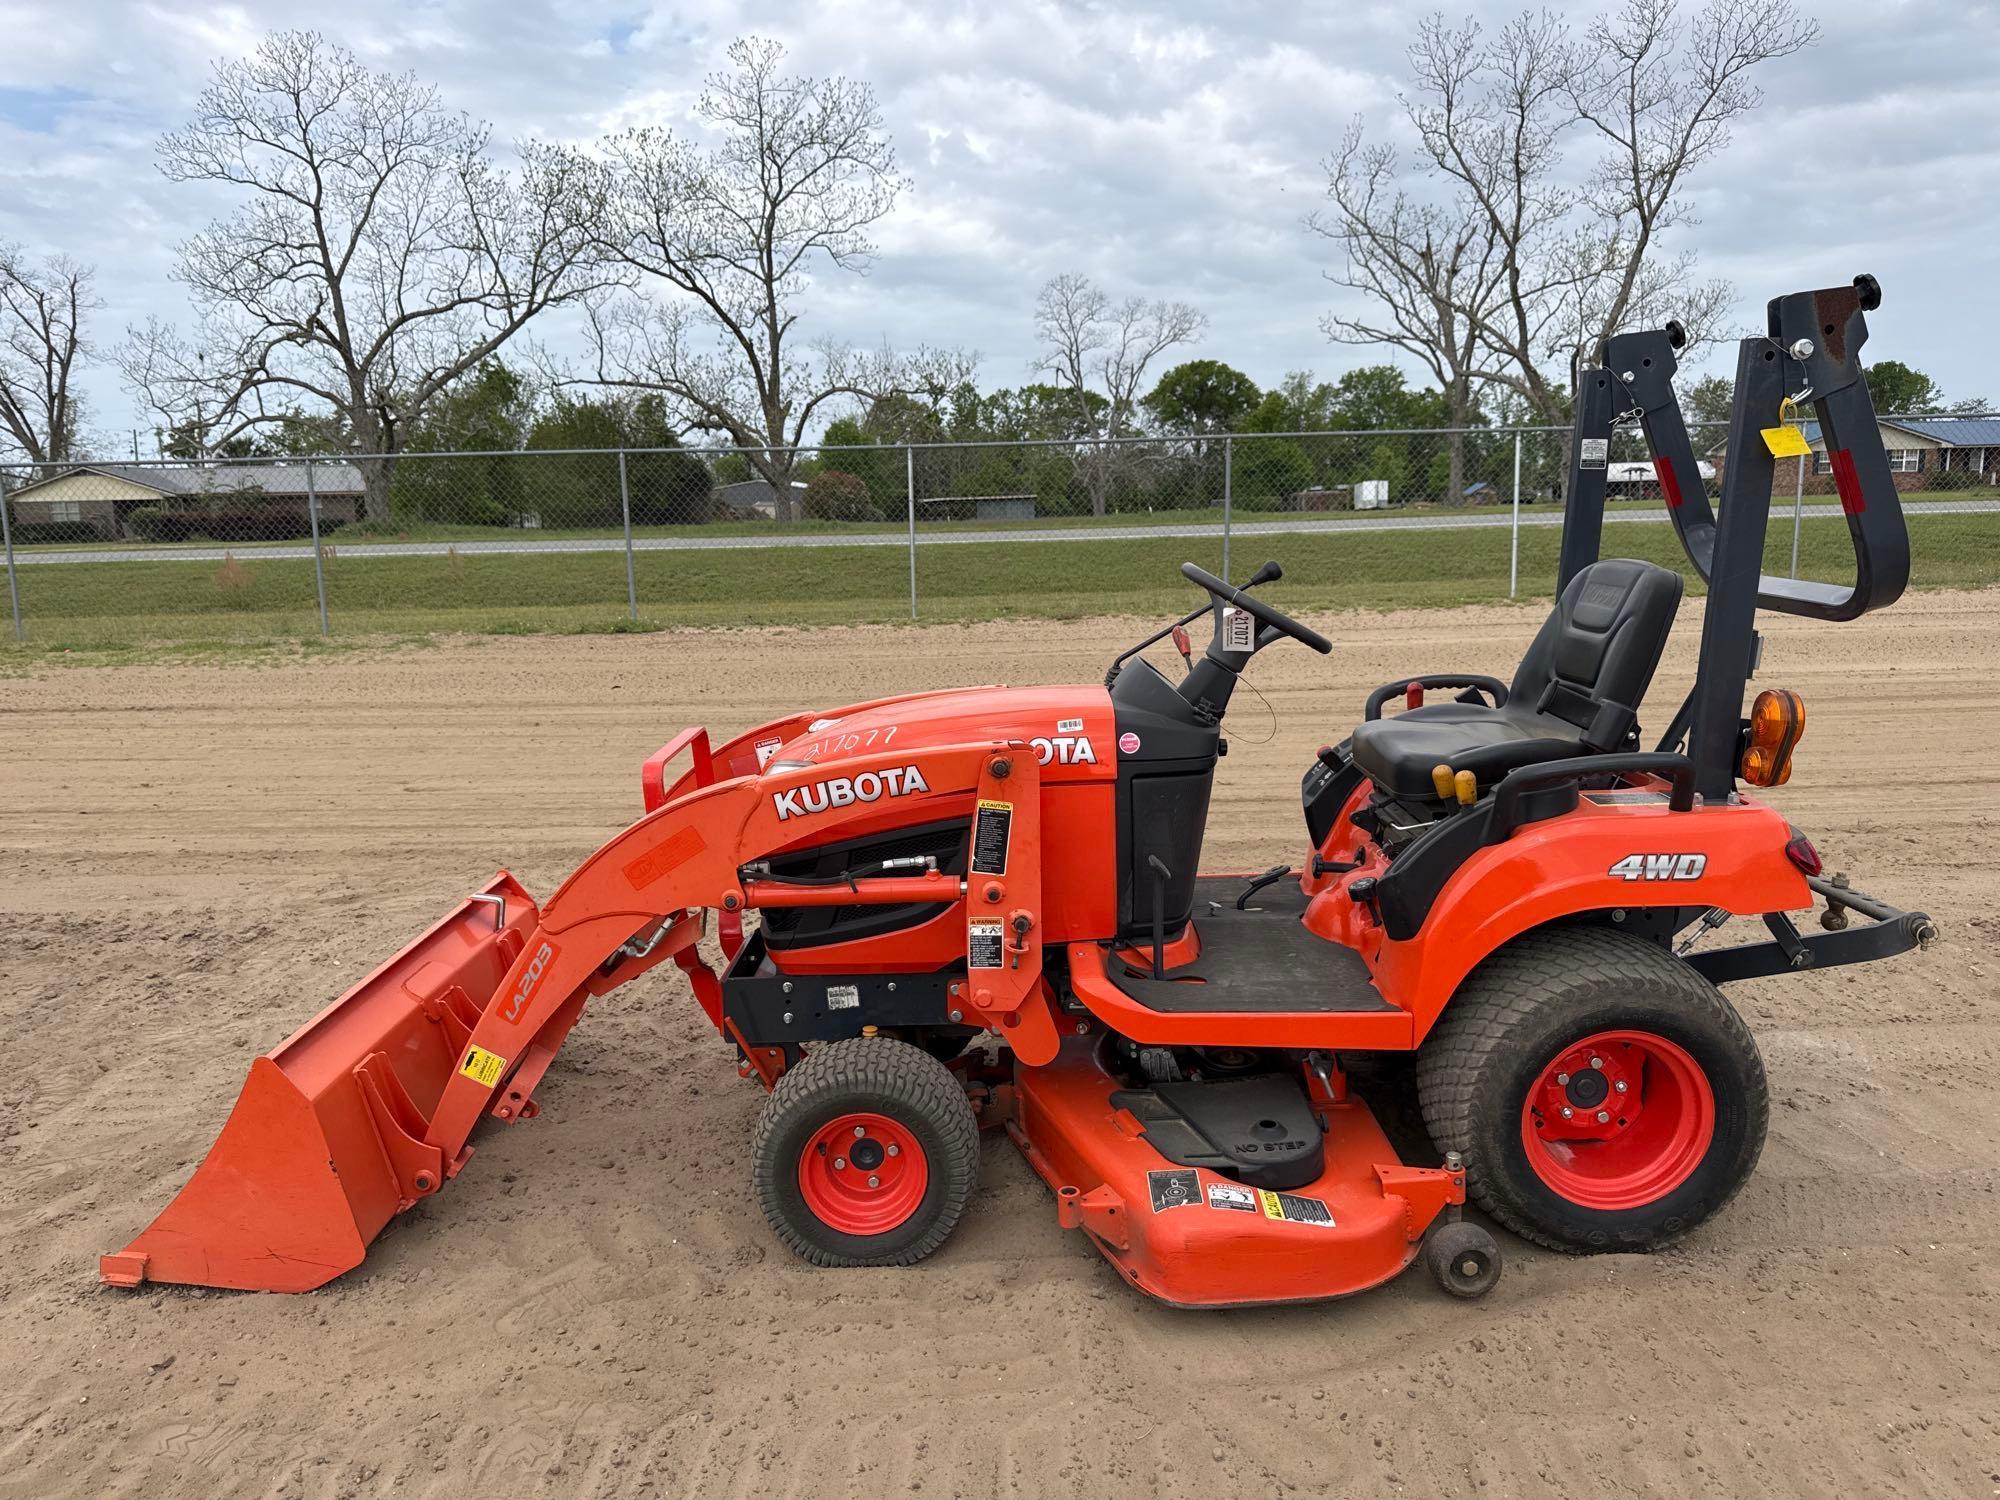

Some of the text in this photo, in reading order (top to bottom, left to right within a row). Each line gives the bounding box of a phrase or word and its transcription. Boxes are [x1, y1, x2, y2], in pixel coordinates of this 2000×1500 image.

[1234, 616, 1249, 646] 217077
[803, 726, 898, 761] 217077
[1008, 737, 1098, 766] OTA
[772, 765, 931, 822] KUBOTA
[986, 802, 1011, 810] CAUTION
[1607, 853, 1707, 881] 4WD
[505, 942, 553, 1022] LA203
[1235, 1140, 1306, 1154] NO STEP
[1217, 1184, 1252, 1194] DANGER
